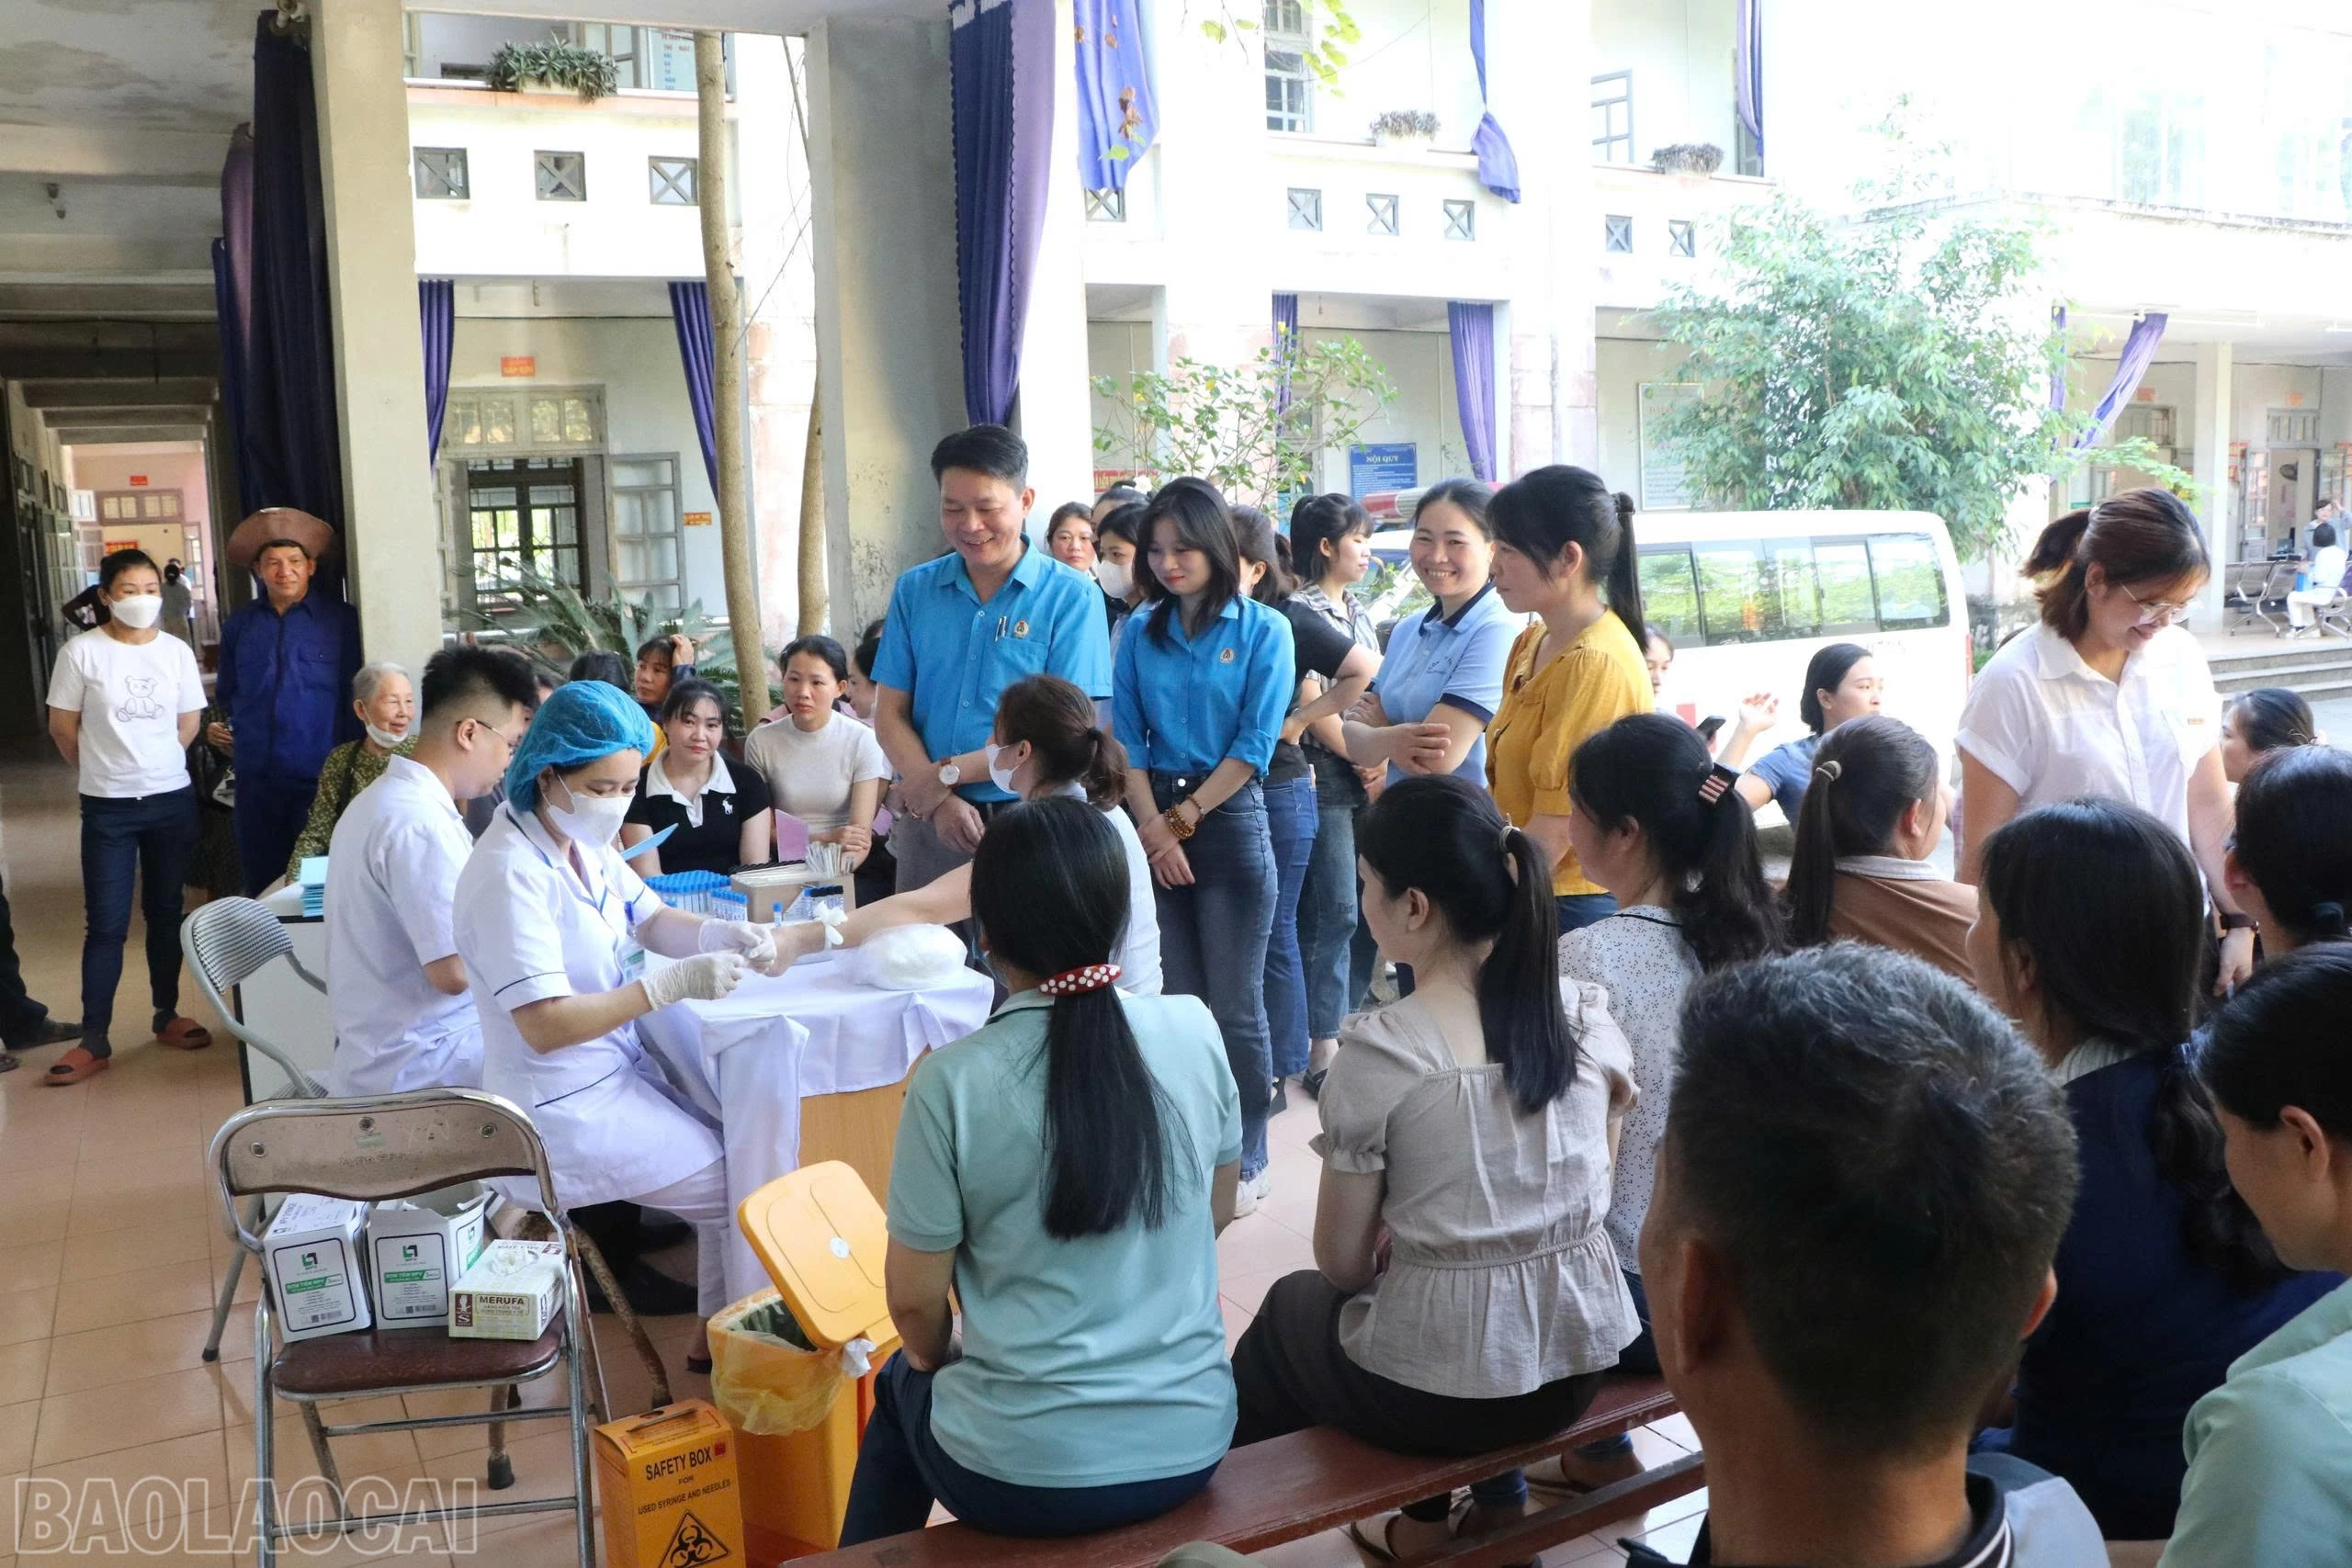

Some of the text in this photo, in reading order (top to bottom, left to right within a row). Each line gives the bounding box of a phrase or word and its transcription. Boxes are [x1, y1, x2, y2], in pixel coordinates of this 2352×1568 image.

[1366, 455, 1399, 464] NỘI QUY
[479, 1295, 525, 1305] MERUFA
[646, 1447, 712, 1481] SAFETY BOX
[678, 1475, 694, 1484] FOR
[638, 1478, 731, 1515] USED SYRINGE AND NEEDLES
